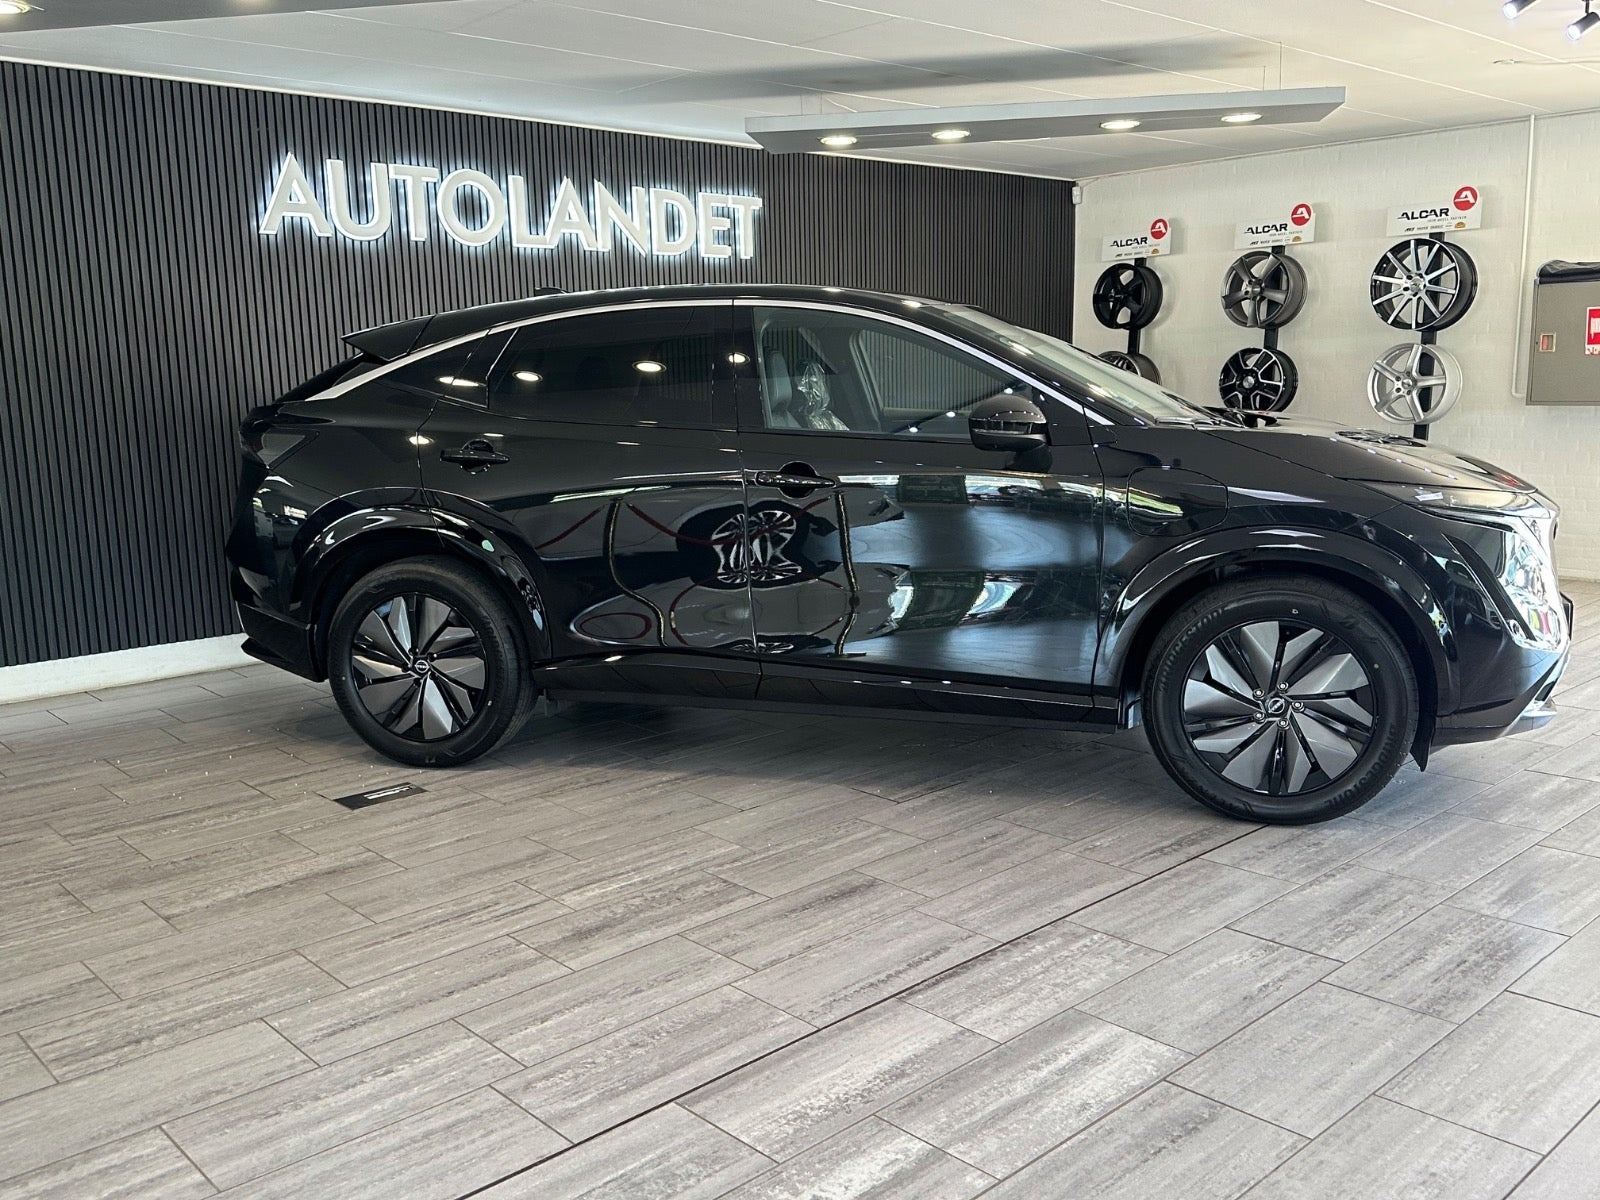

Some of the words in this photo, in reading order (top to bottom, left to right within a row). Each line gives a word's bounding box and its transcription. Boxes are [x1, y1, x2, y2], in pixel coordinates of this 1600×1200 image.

[259, 151, 763, 260] AUTOLANDET
[1397, 207, 1450, 221] ALCAR
[1244, 223, 1288, 235] ALCAR
[1110, 236, 1148, 248] ALCAR
